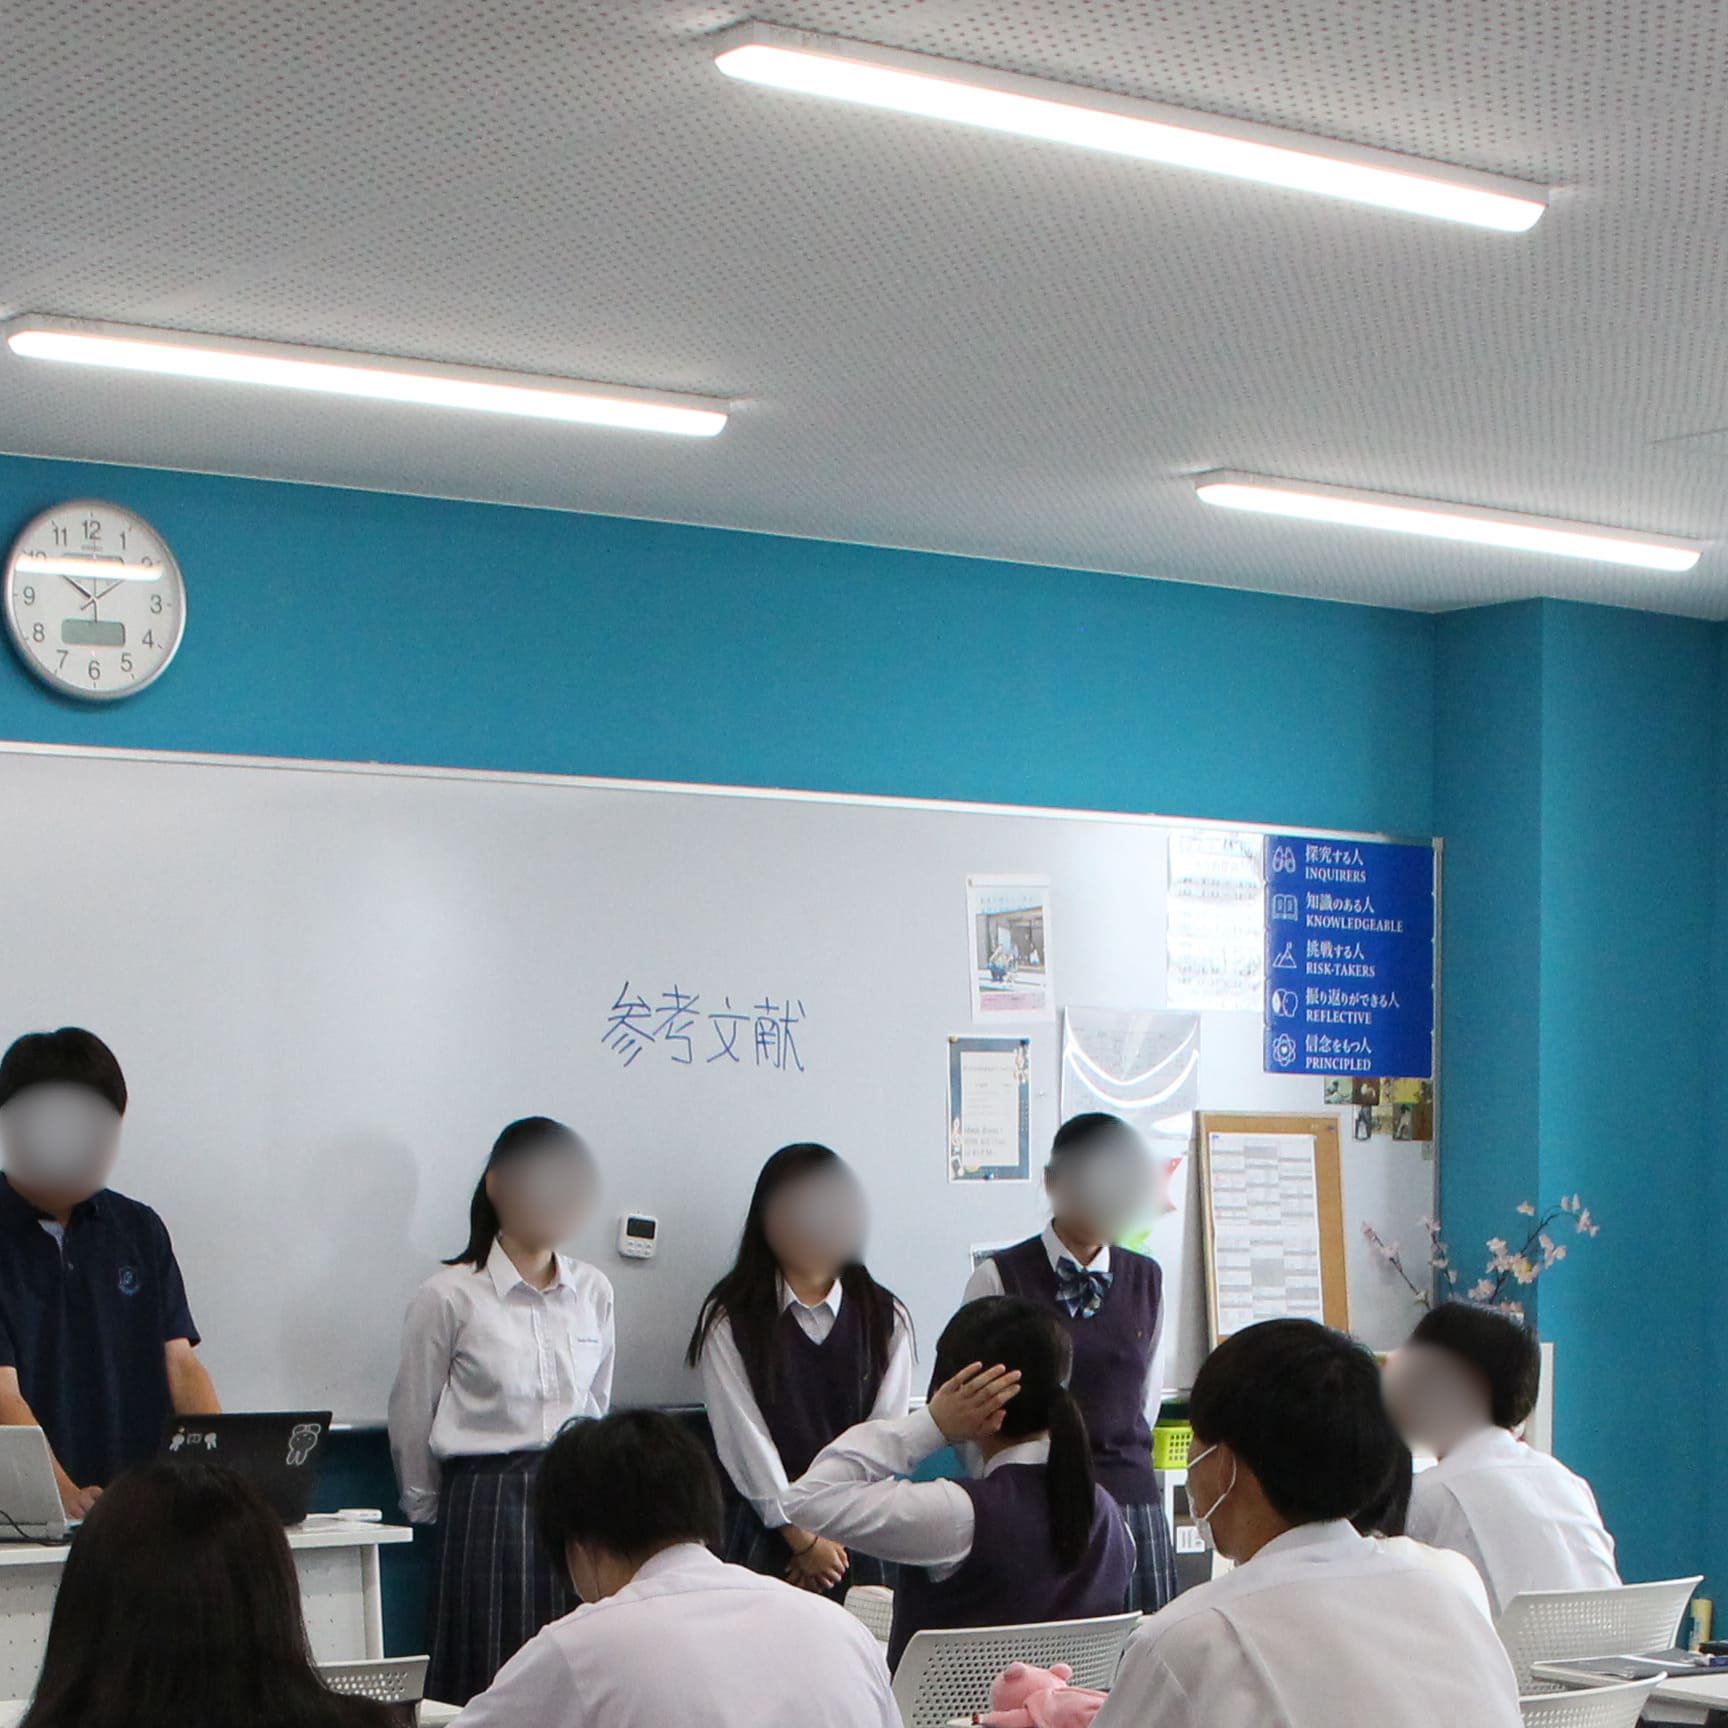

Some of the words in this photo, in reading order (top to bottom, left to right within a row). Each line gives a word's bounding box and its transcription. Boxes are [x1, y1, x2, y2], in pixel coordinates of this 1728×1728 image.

[53, 527, 68, 546] 11
[82, 520, 101, 540] 12
[120, 531, 126, 550] 1
[23, 586, 36, 605] 9
[150, 595, 162, 614] 3
[32, 623, 45, 642] 8
[142, 630, 154, 648] 4
[56, 650, 69, 669] 7
[121, 654, 133, 672] 5
[88, 661, 101, 680] 6
[1305, 843, 1364, 866] 探究する人
[1305, 866, 1366, 882] INQUIRERS
[1306, 891, 1375, 914] 知識のある人
[1306, 914, 1403, 933] KNOWLEDGEABLE
[1306, 938, 1365, 960] 挑戦する人
[1305, 962, 1375, 978] RISK-TAKERS
[1305, 986, 1400, 1009] 振り返りができる人
[601, 981, 805, 1072] 参考文献
[1306, 1009, 1371, 1025] REFLECTIVE
[1305, 1034, 1372, 1055] 信念をもつ人
[1305, 1056, 1371, 1071] PRINCIPLED
